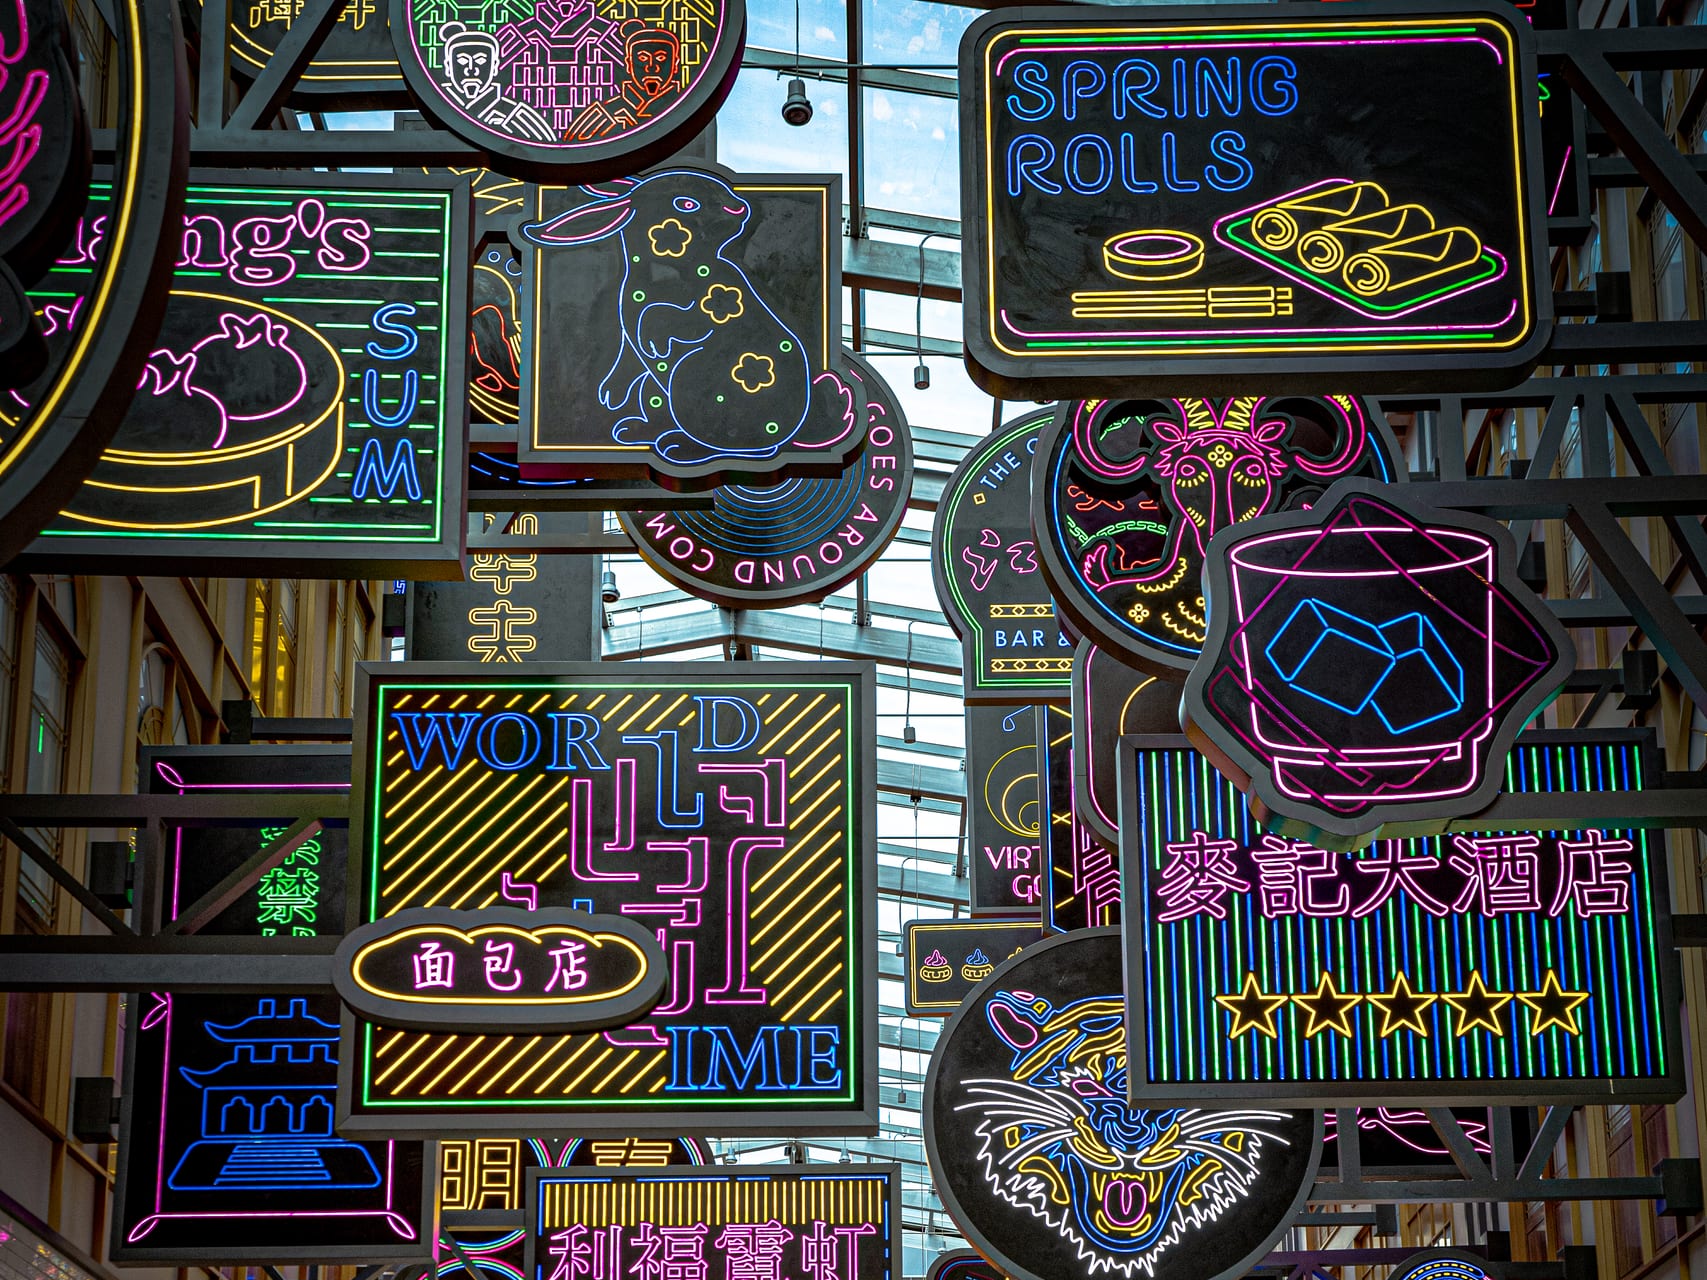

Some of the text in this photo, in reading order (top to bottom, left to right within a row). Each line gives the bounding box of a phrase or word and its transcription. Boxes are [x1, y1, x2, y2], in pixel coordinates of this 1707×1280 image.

[1007, 57, 1298, 121] SPRING
[1008, 131, 1254, 196] ROLLS
[352, 302, 421, 500] SUM
[979, 451, 1022, 490] THE
[637, 510, 716, 573] COM
[734, 503, 879, 584] AROUND
[994, 629, 1045, 648] BAR
[1156, 829, 1634, 922] 麥記大酒店
